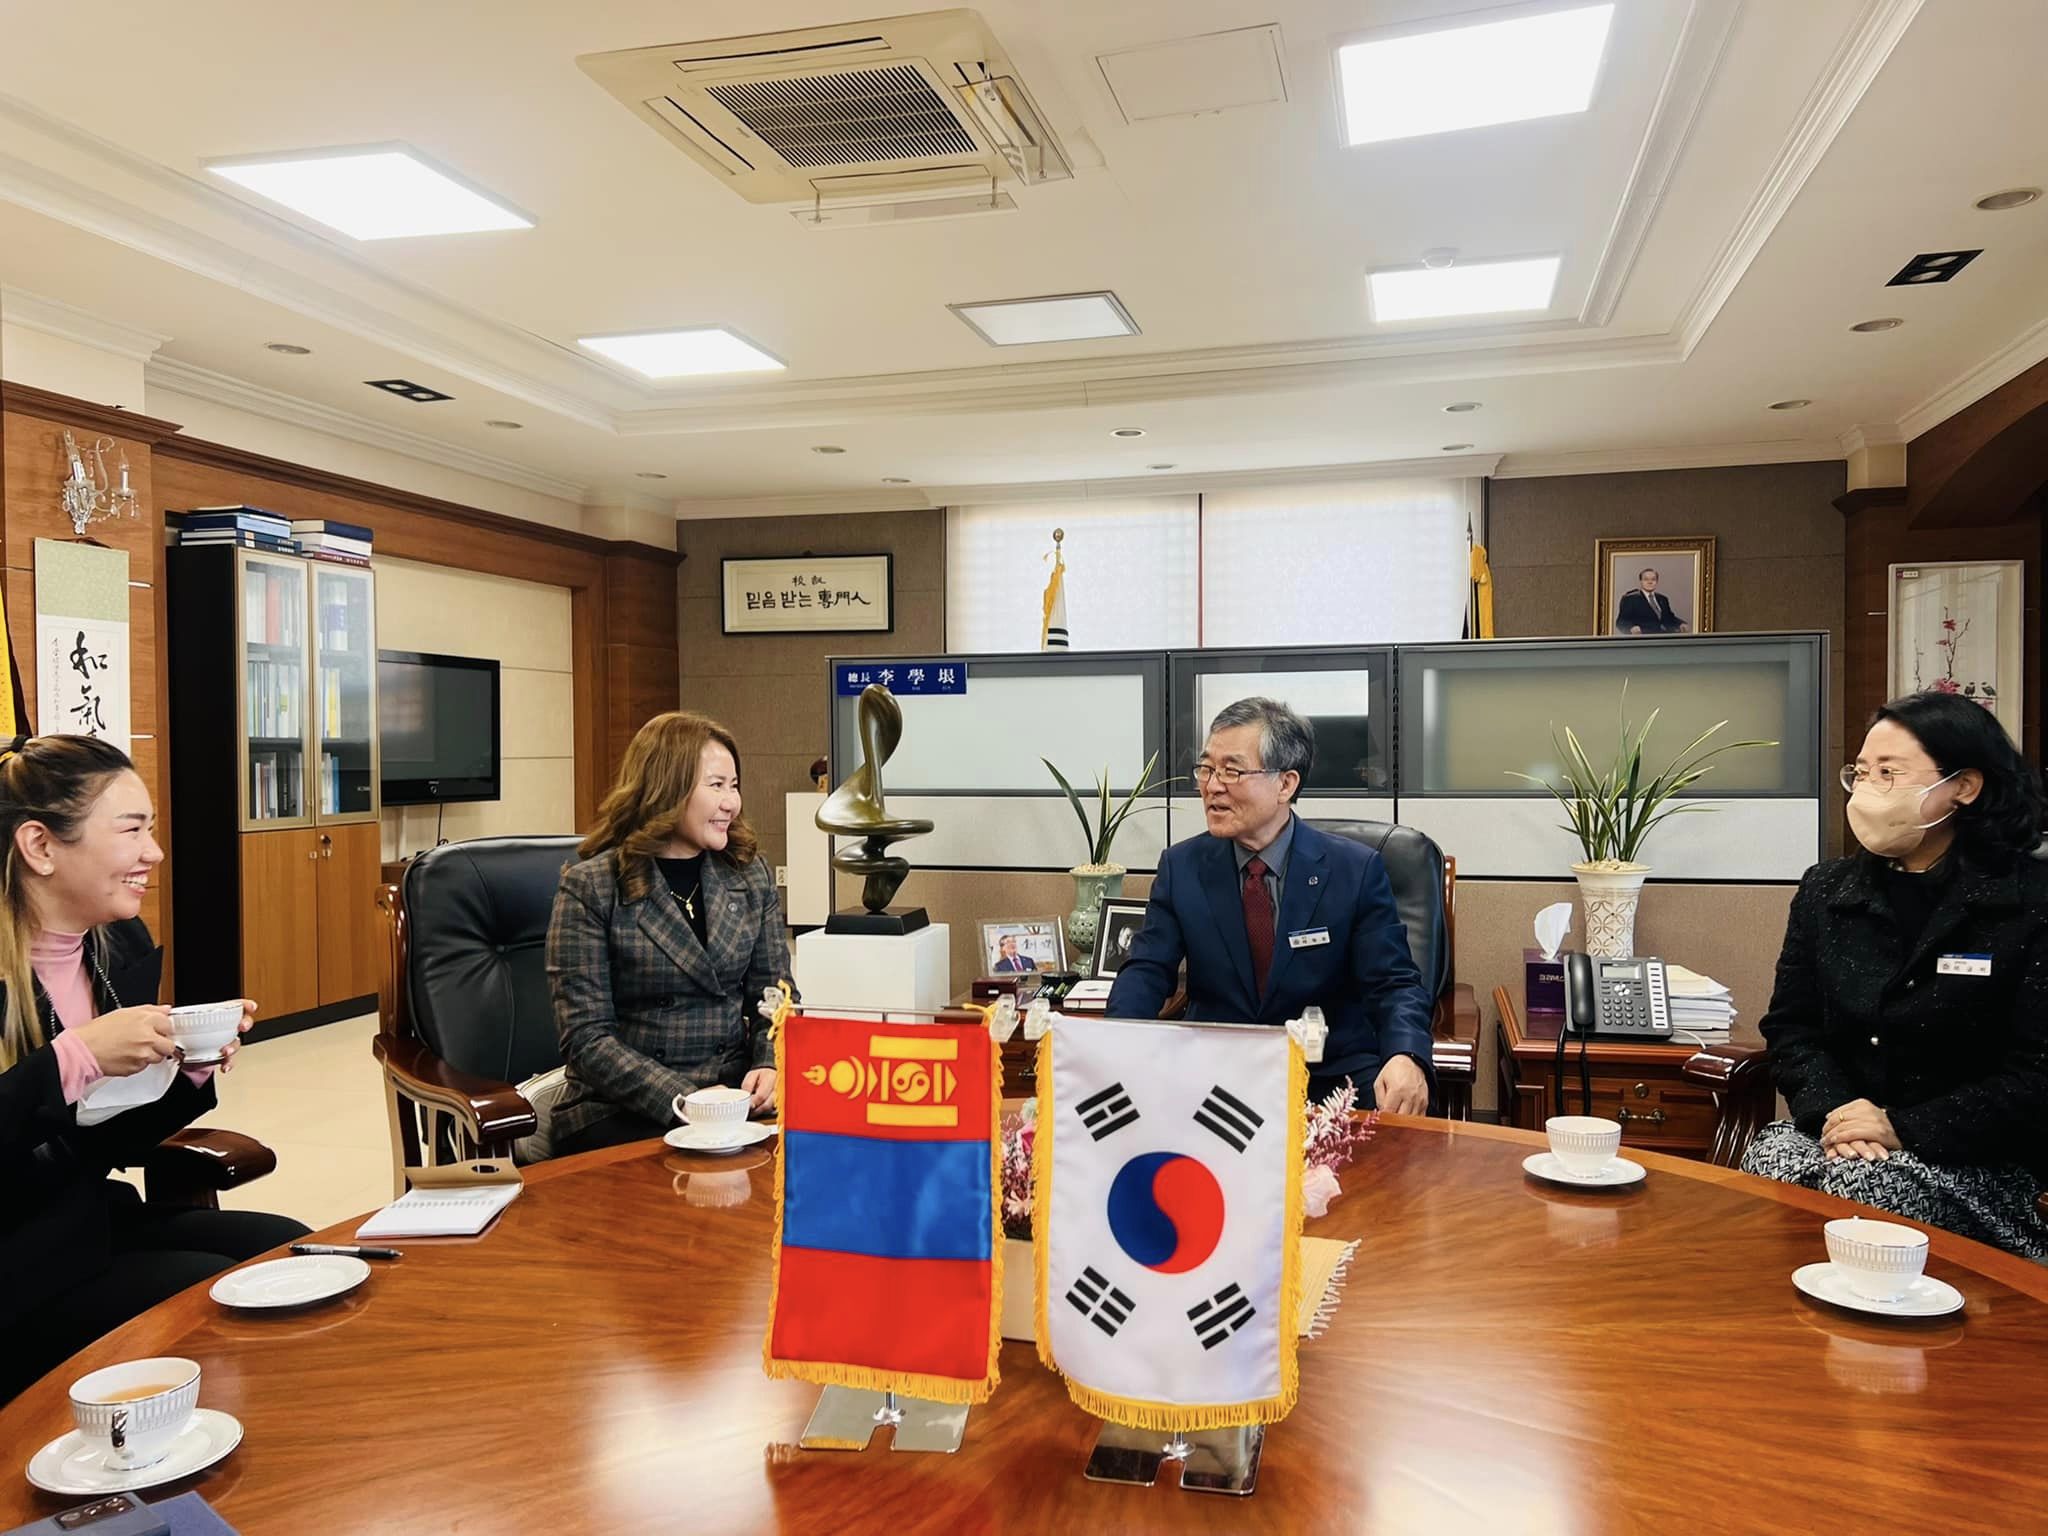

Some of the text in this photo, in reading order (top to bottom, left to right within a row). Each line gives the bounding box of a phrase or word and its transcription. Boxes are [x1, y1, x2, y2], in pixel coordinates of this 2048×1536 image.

[746, 588, 871, 610] 믿음 받는 專門人
[848, 672, 871, 683] 總長
